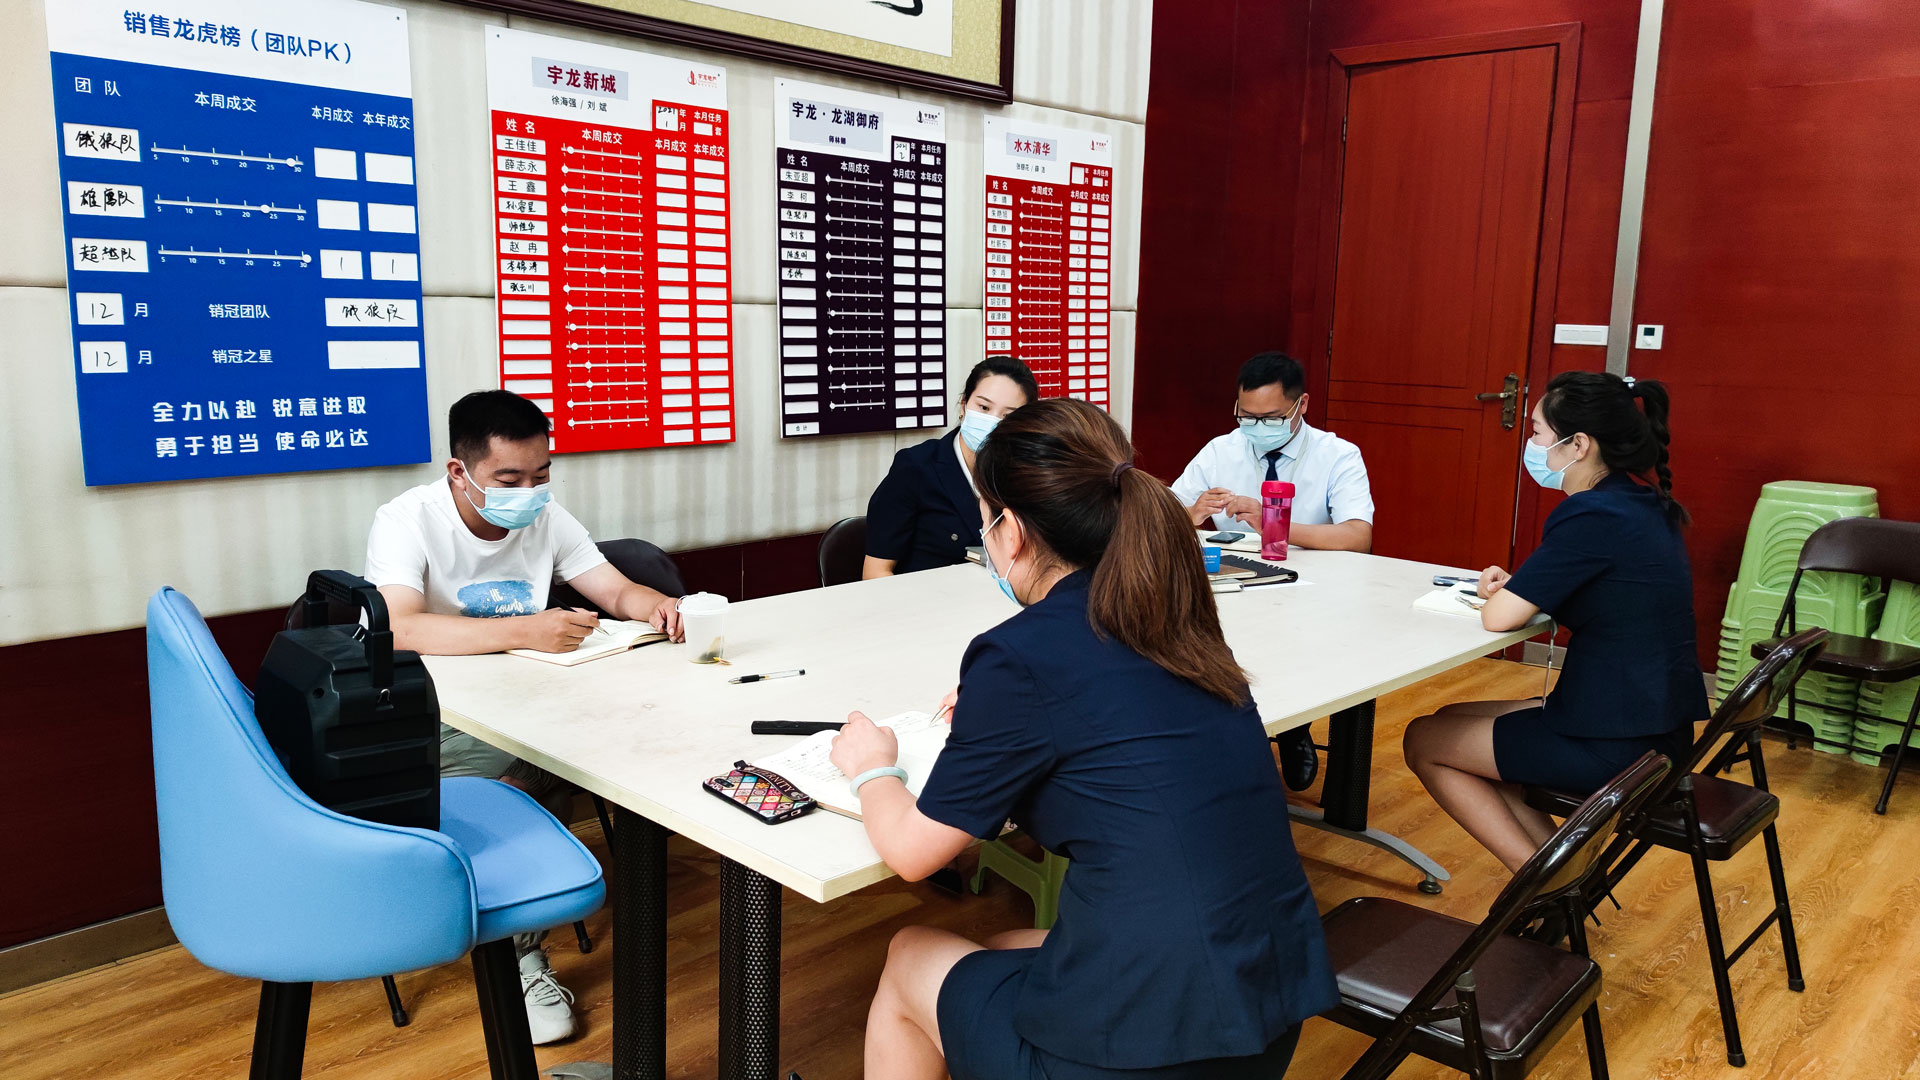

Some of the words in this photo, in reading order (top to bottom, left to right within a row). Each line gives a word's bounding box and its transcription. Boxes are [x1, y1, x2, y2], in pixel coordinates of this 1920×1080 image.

[123, 10, 352, 65] 销售龙虎榜（团队PK）
[547, 65, 617, 93] 宇龙新城
[195, 92, 256, 112] 本周成交
[552, 95, 577, 108] 徐海强
[312, 106, 353, 123] 本月成交
[362, 111, 411, 130] 本年成交
[679, 108, 687, 118] 年
[693, 110, 722, 124] 本月任务
[792, 101, 879, 131] 宇龙·龙湖御府
[680, 122, 687, 132] 月
[581, 128, 623, 145] 本周成交
[504, 139, 537, 153] 王佳佳
[655, 138, 687, 155] 本月成交
[693, 143, 725, 160] 本年成交
[1014, 138, 1051, 156] 水木清华
[504, 158, 538, 172] 薛志永
[840, 161, 870, 175] 本周成交
[893, 168, 916, 180] 本月成交
[920, 172, 943, 184] 本年成交
[1031, 185, 1053, 197] 本周成交
[1070, 190, 1089, 200] 本月成交
[1092, 192, 1110, 203] 本年成交
[91, 302, 114, 319] 12
[134, 303, 149, 318] 月
[208, 304, 271, 319] 销冠团队
[95, 351, 118, 368] 12
[138, 350, 152, 365] 月
[212, 349, 273, 364] 销冠之星
[153, 400, 256, 423] 全力以赴
[272, 396, 367, 418] 锐意进取
[155, 433, 259, 458] 勇于担当
[275, 428, 369, 451] 使命必达
